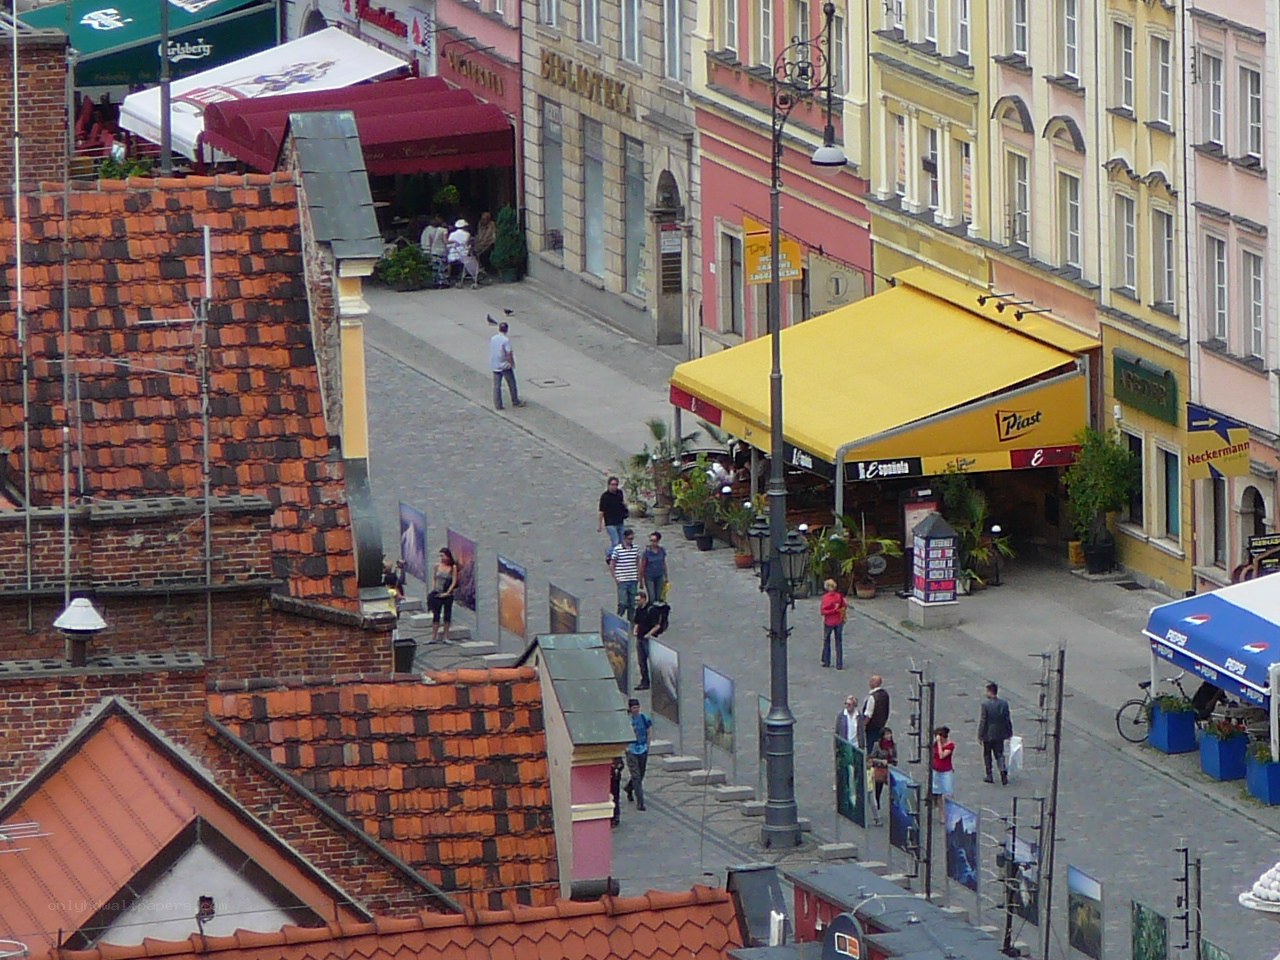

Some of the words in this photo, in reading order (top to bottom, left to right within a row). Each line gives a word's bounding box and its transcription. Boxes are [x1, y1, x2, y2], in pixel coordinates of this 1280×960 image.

[540, 46, 637, 121] BIBLIOTEKA
[1001, 410, 1043, 436] Piast
[1187, 441, 1250, 466] Neckermann
[1166, 628, 1188, 647] PEPSI
[1224, 657, 1248, 676] PEPSI
